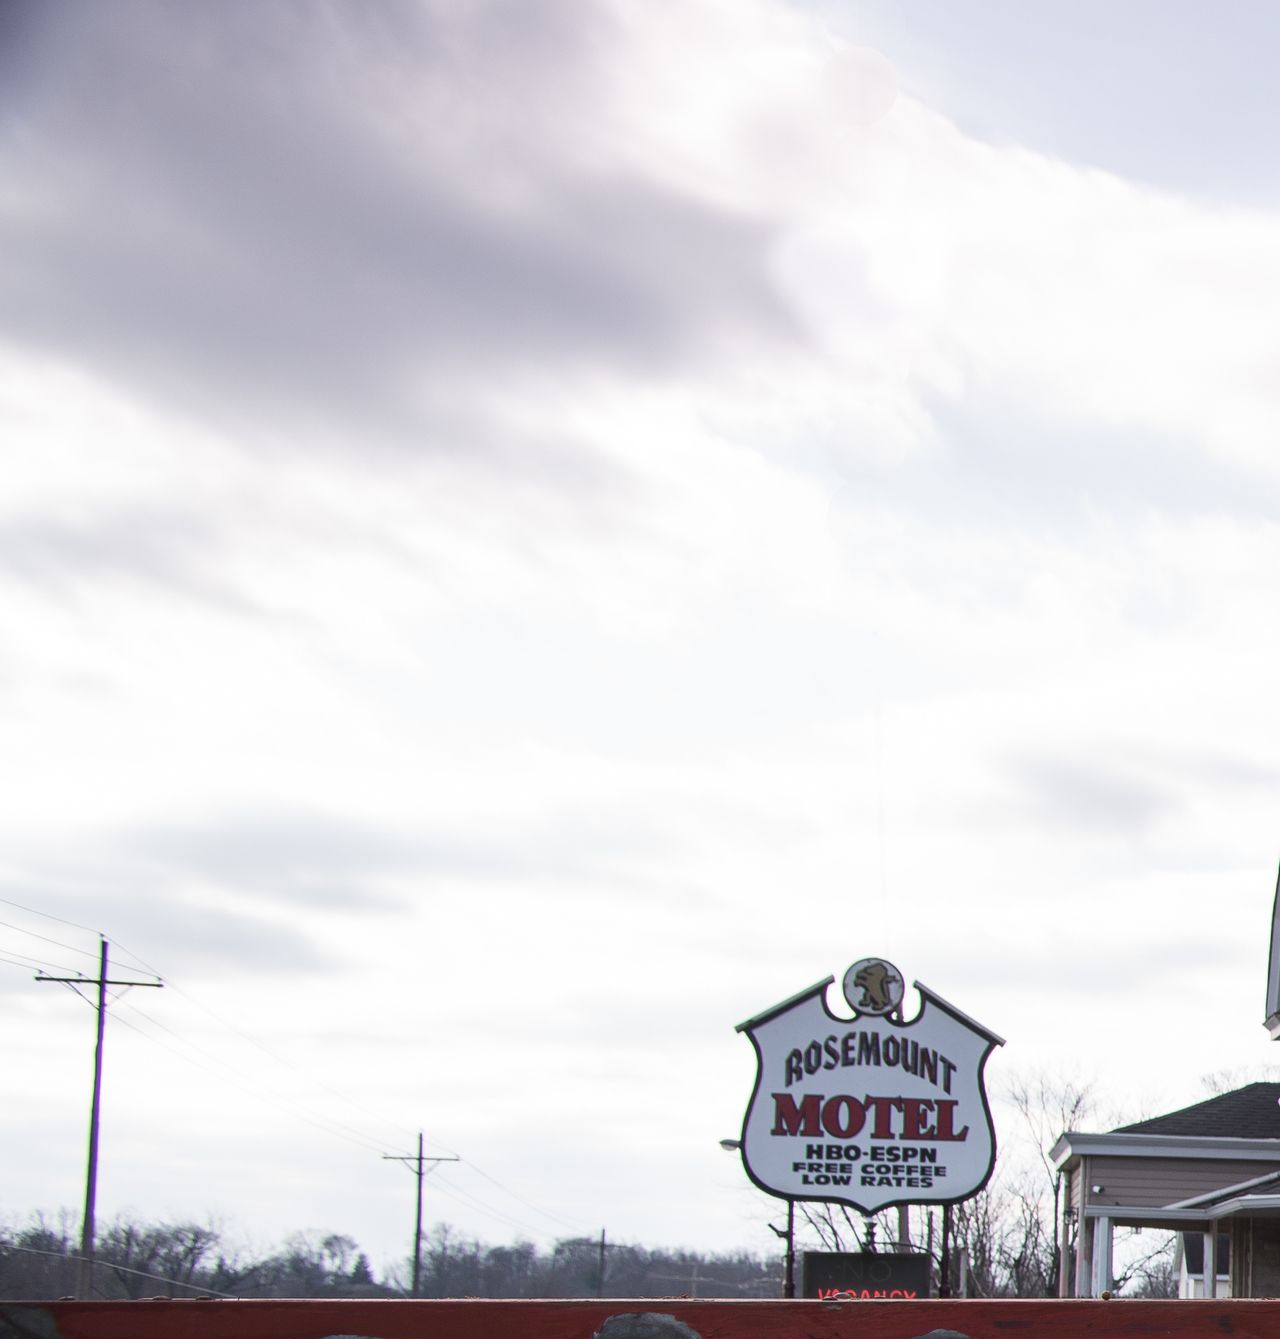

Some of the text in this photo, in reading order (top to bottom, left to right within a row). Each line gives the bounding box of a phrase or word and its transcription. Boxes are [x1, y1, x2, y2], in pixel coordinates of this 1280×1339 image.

[785, 1031, 957, 1095] ROSEMOUNT
[770, 1092, 970, 1142] MOTEL
[806, 1144, 937, 1163] HBO-ESPN
[792, 1162, 947, 1177] FREE COFFEE
[802, 1174, 933, 1188] LOW RATES
